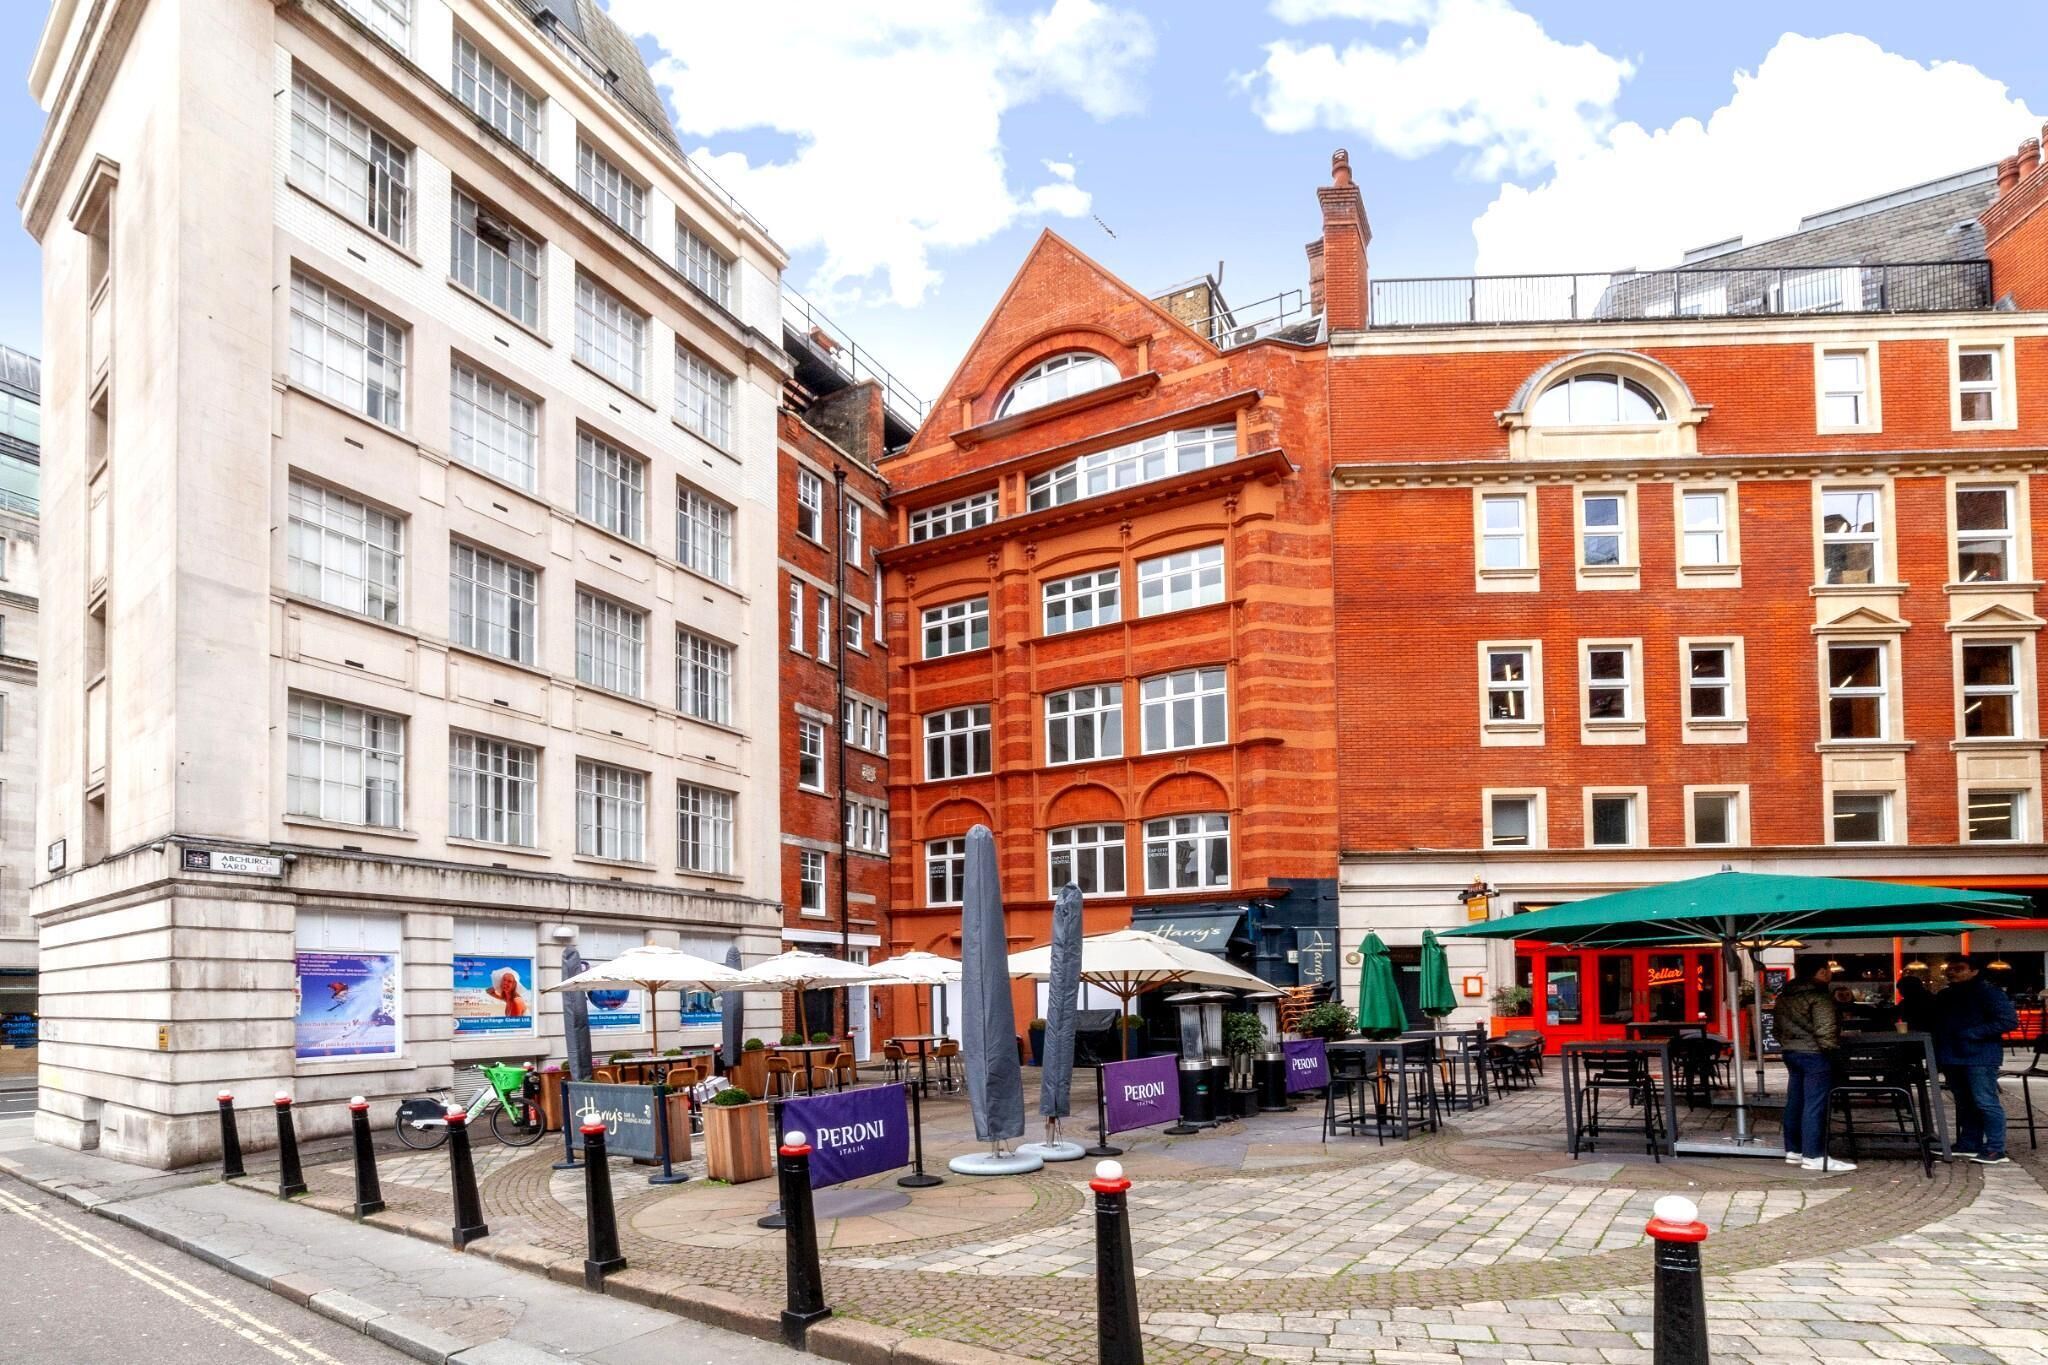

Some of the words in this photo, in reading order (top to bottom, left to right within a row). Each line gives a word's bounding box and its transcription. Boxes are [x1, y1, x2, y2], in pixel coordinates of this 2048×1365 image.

[221, 855, 272, 866] ABCHURCH
[221, 862, 247, 871] YARD
[1149, 923, 1221, 943] Harry's
[1302, 930, 1332, 982] Harry's
[1291, 1057, 1318, 1071] PERONI
[1124, 1081, 1165, 1102] PERONI
[816, 1119, 885, 1150] PERONI
[839, 1145, 865, 1156] ITALIA
